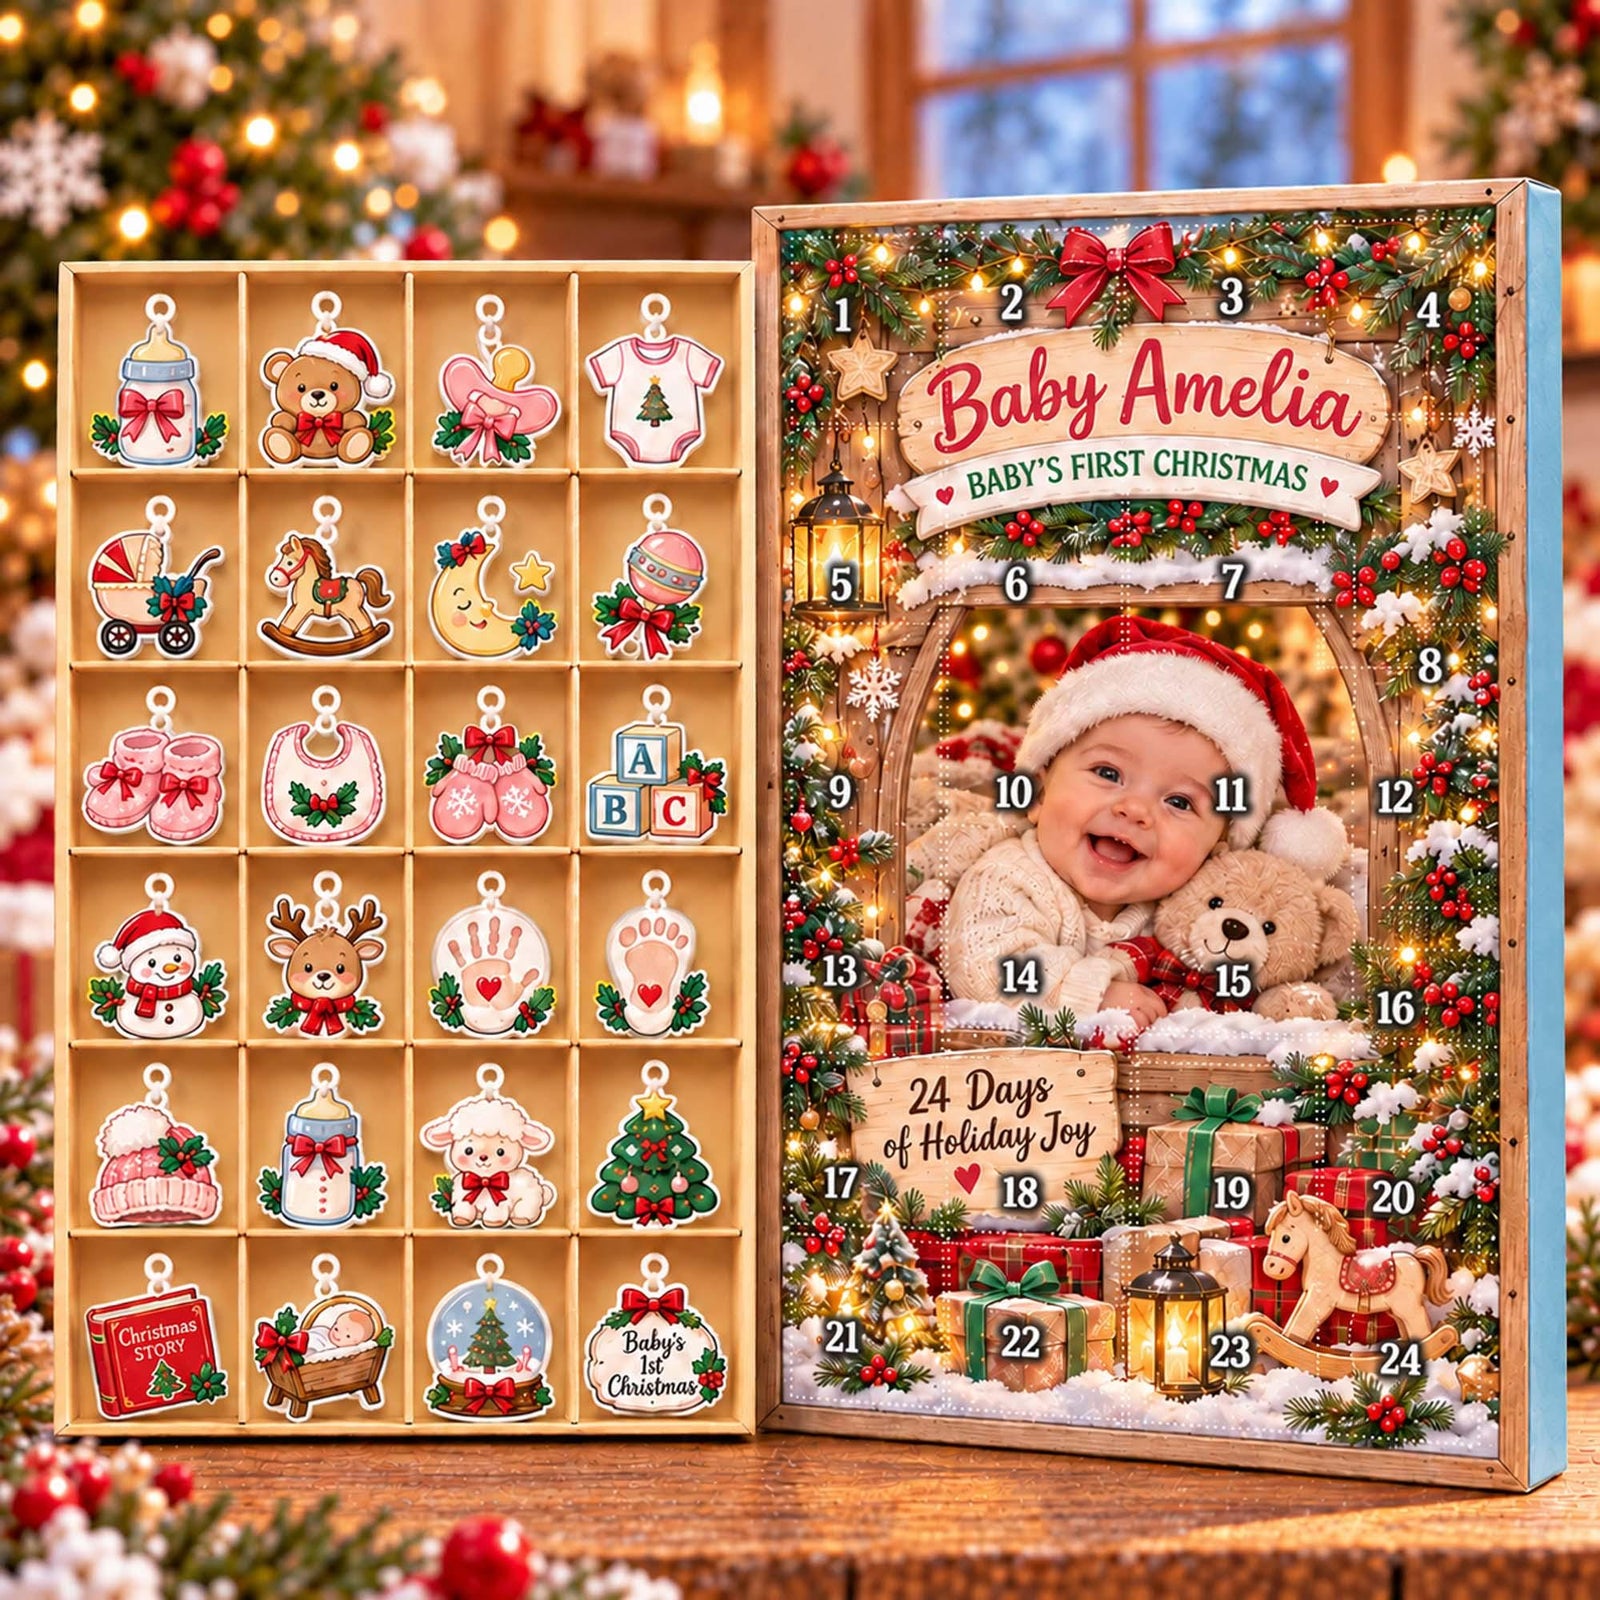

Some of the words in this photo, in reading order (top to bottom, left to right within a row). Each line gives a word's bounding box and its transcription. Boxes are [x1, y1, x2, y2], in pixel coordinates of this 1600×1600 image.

[1001, 286, 1023, 319] 2
[1221, 279, 1243, 313] 3
[1417, 293, 1440, 327] 4
[835, 299, 851, 332] 1
[927, 346, 1108, 454] Baby
[1119, 338, 1362, 438] Amelia
[967, 456, 1062, 500] BABY’S
[1071, 450, 1145, 480] FIRST
[1153, 449, 1308, 491] CHRISTMAS
[831, 566, 852, 600] 5
[1006, 566, 1028, 599] 6
[1222, 564, 1244, 598] 7
[1419, 650, 1441, 683] 8
[628, 743, 656, 775] A
[829, 776, 851, 808] 9
[996, 776, 1032, 808] 10
[1216, 779, 1247, 811] 11
[1378, 781, 1412, 812] 12
[603, 794, 627, 824] B
[663, 796, 686, 826] C
[823, 956, 856, 986] 13
[1002, 961, 1038, 993] 14
[1217, 964, 1251, 997] 15
[1378, 992, 1414, 1024] 16
[909, 1077, 951, 1116] 24
[966, 1069, 1053, 1116] Days
[883, 1125, 912, 1170] of
[921, 1119, 1036, 1161] Holiday
[1040, 1111, 1096, 1158] Joy
[824, 1167, 858, 1198] 17
[1003, 1176, 1038, 1209] 18
[1216, 1176, 1249, 1208] 19
[1373, 1180, 1414, 1212] 20
[118, 1320, 197, 1348] Christmas
[134, 1339, 186, 1360] STORY
[623, 1329, 686, 1357] Baby's
[825, 1321, 858, 1352] 21
[1002, 1326, 1039, 1358] 22
[640, 1354, 663, 1375] 1st
[1211, 1334, 1251, 1368] 23
[1380, 1342, 1421, 1375] 24
[608, 1374, 698, 1399] Christmas
